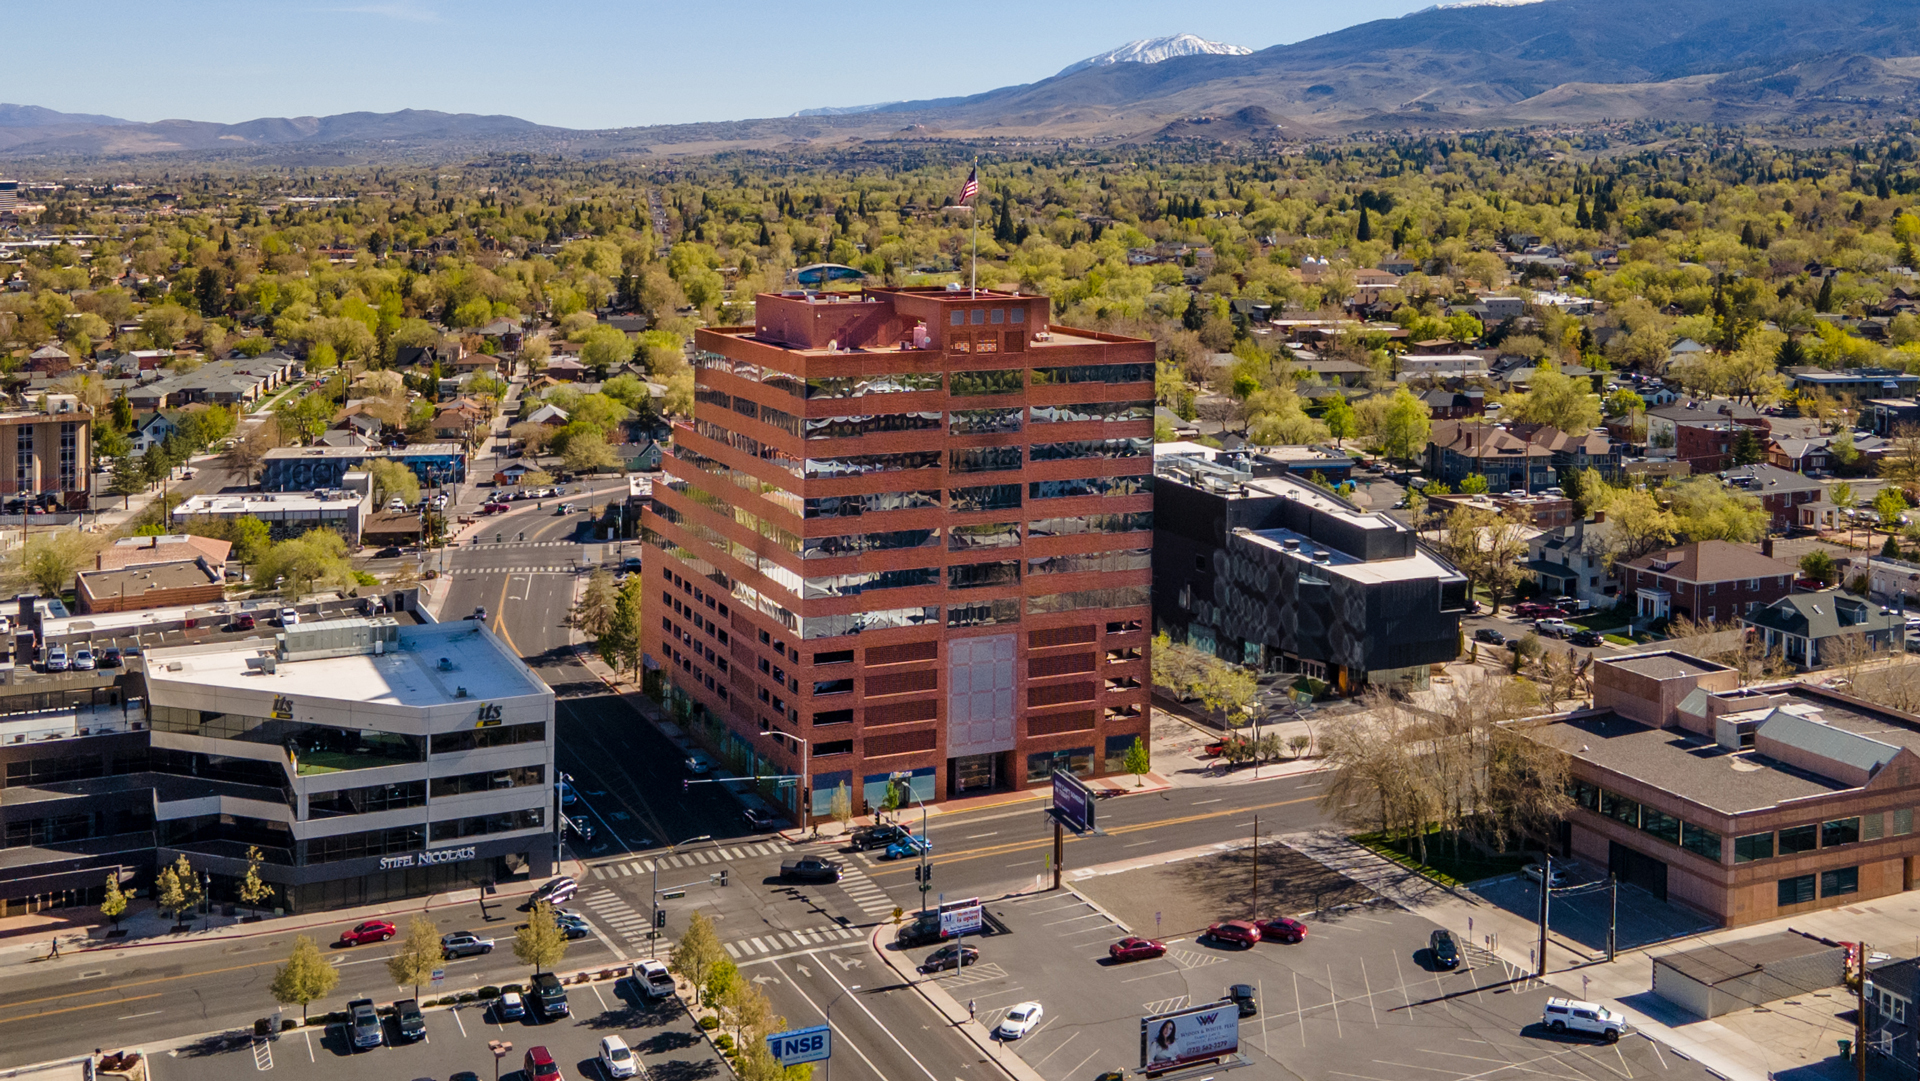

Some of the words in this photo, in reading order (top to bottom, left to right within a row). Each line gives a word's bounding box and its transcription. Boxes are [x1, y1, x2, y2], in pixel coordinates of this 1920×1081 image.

[380, 856, 415, 870] STIFEL
[418, 846, 476, 866] NICOLAUS
[785, 1035, 823, 1055] NSB
